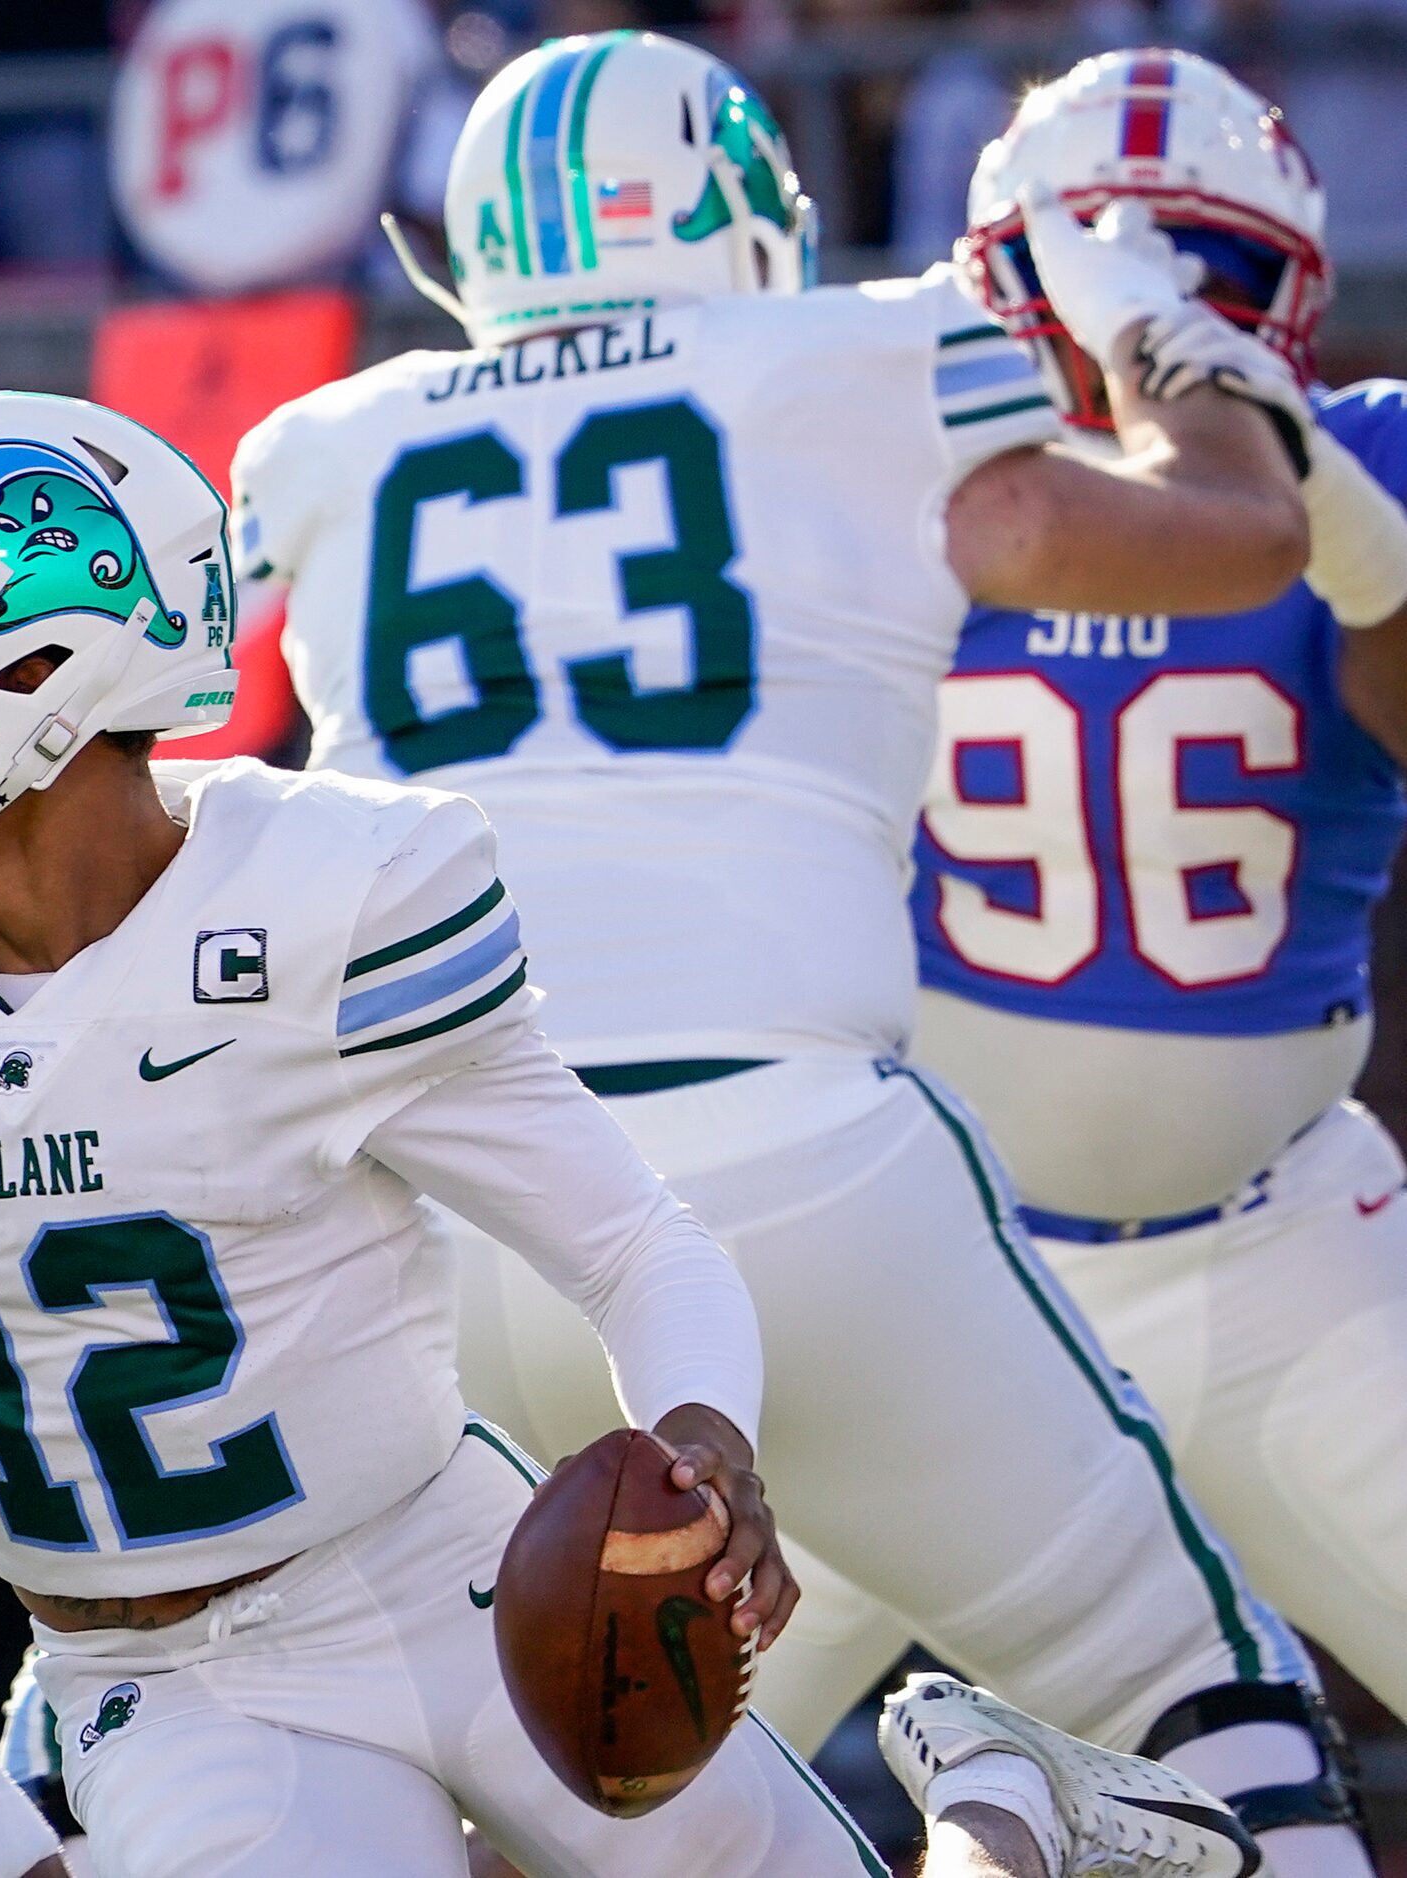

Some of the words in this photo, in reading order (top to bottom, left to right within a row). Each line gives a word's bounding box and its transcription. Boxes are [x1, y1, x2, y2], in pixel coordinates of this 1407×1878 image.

[153, 18, 337, 200] P6
[202, 564, 228, 621] A
[207, 627, 223, 648] P6
[365, 392, 760, 778] 63
[921, 667, 1307, 991] 96
[197, 932, 264, 1000] C
